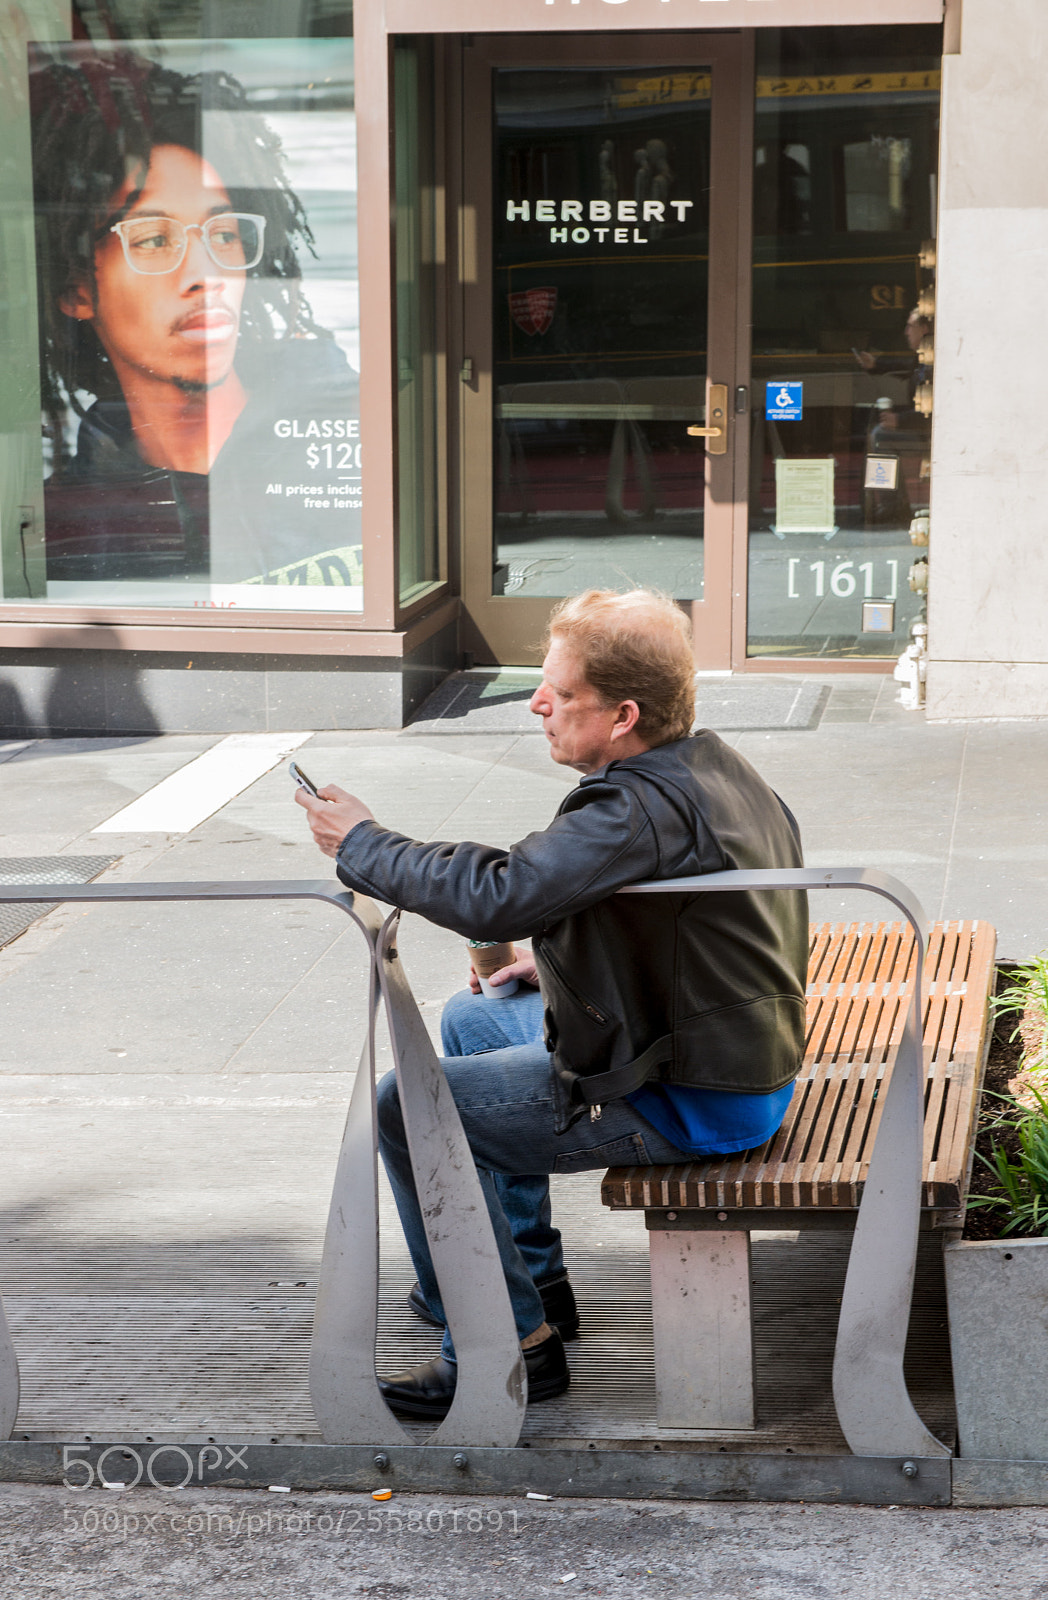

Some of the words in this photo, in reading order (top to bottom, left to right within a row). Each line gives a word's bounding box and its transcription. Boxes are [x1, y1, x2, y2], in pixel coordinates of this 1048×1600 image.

[506, 200, 694, 222] HERBERT
[550, 227, 648, 243] HOTEL
[265, 484, 282, 494] All
[286, 484, 324, 497] prices
[304, 498, 330, 508] free
